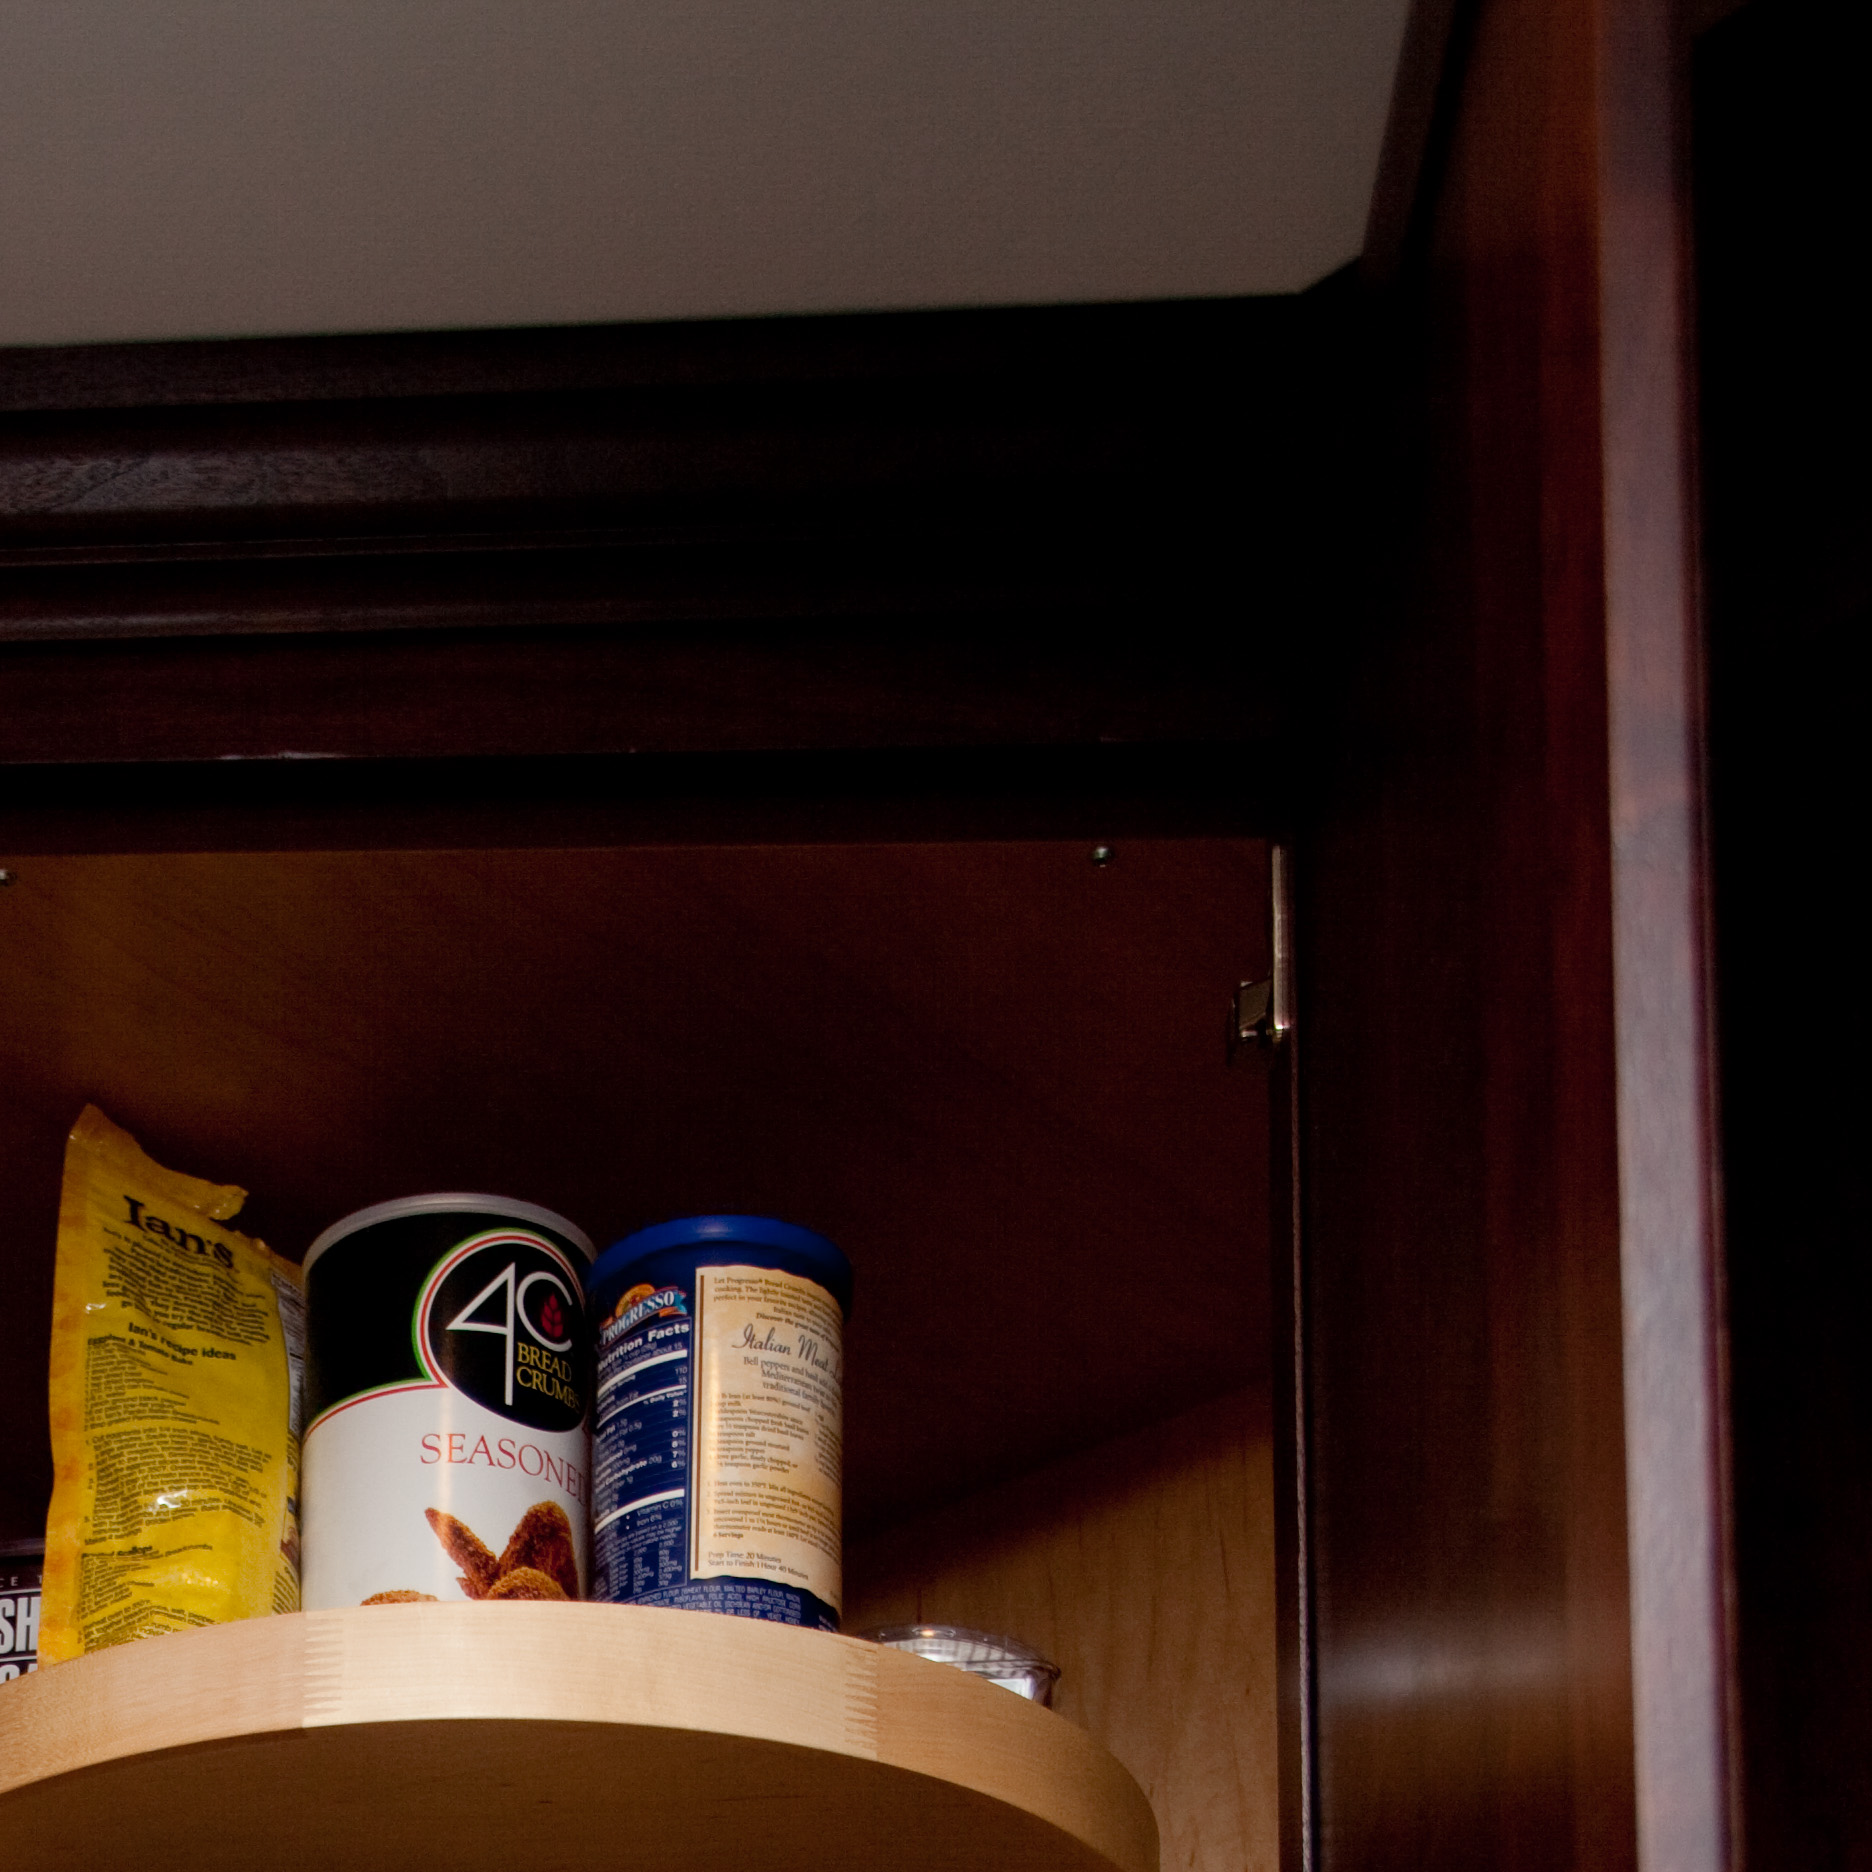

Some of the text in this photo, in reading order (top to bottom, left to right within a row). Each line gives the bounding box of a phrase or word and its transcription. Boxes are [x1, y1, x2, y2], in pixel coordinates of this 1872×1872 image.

[123, 1195, 234, 1268] Ian's
[600, 1290, 676, 1346] PROGRESSO
[648, 1323, 690, 1342] Facts
[129, 1322, 236, 1360] Ian's recipe ideas
[731, 1323, 792, 1356] Italian
[517, 1341, 572, 1382] BREAD
[743, 1356, 759, 1366] Bell
